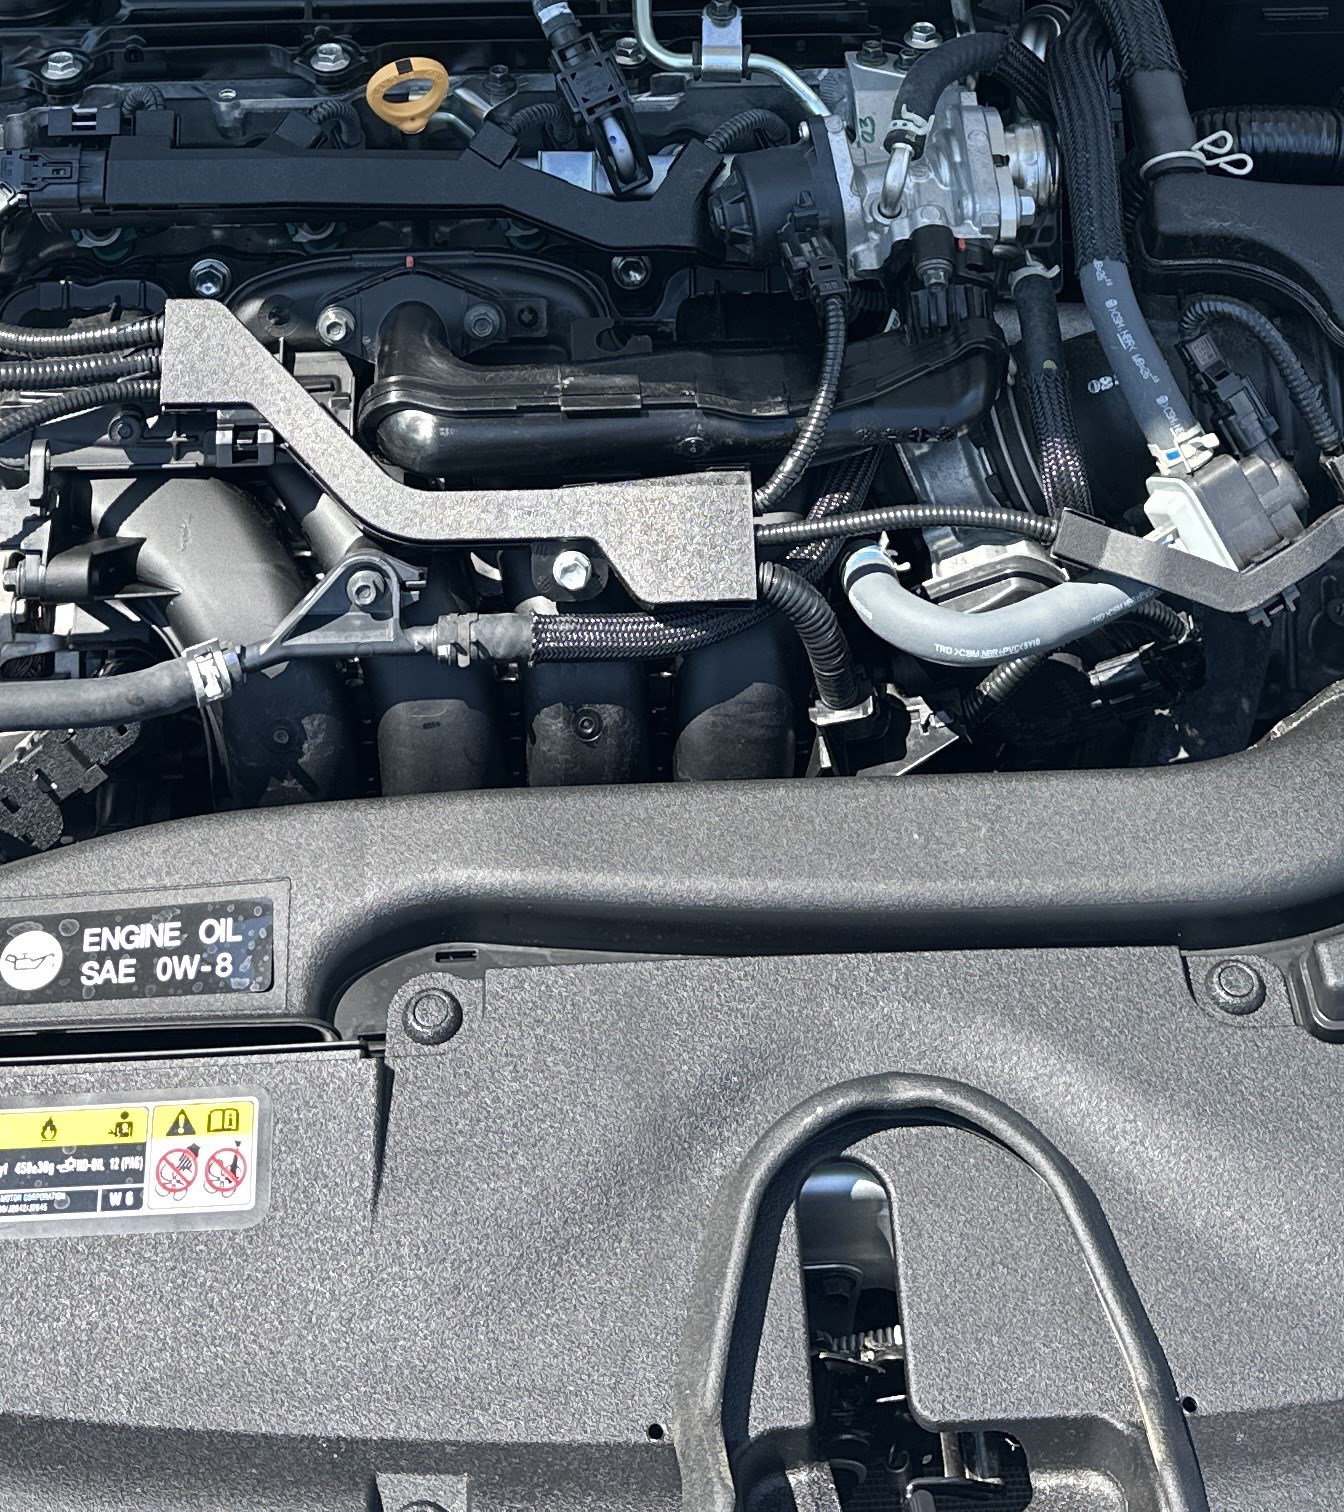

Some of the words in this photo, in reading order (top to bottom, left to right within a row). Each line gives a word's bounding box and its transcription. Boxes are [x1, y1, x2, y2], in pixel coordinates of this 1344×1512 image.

[82, 921, 183, 953] ENGINE
[198, 918, 243, 945] OIL
[80, 958, 137, 987] SAE
[156, 952, 234, 982] 0W-8
